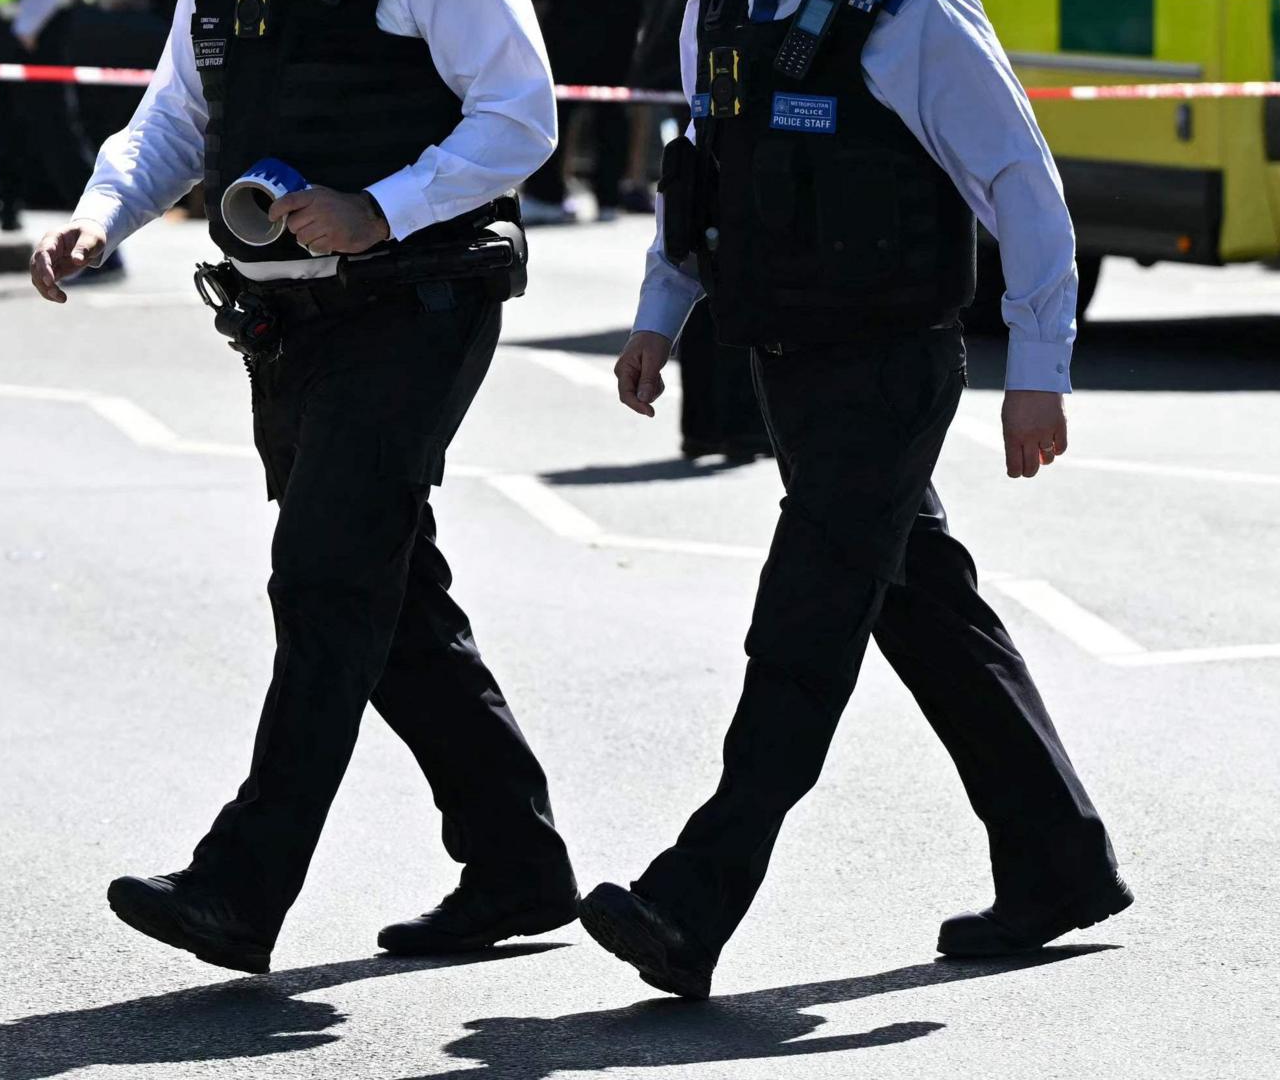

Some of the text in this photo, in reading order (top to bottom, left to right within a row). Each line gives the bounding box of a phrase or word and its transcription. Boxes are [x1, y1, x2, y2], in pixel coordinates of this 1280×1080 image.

[790, 100, 829, 109] METROPOLITAN
[794, 108, 824, 116] POLICE
[773, 115, 832, 128] POLICE STAFF
